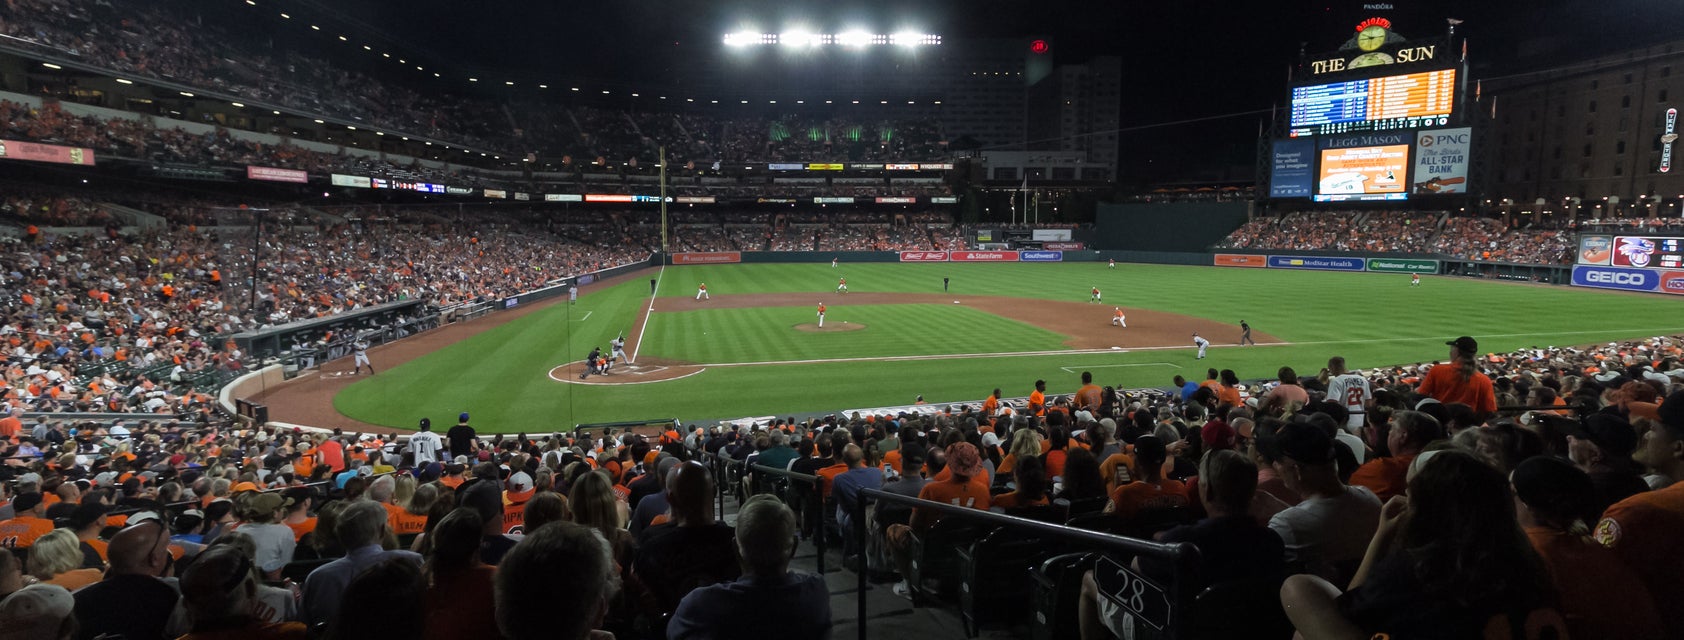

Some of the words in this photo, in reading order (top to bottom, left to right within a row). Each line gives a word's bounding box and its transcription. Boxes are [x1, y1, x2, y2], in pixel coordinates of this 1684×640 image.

[1311, 58, 1345, 74] THE
[1397, 45, 1435, 64] SUN
[1329, 137, 1358, 148] LEGG
[1361, 135, 1402, 146] MASON
[1437, 134, 1468, 145] PNC
[1420, 155, 1464, 165] ALL-STAR
[1429, 165, 1453, 174] BANK
[1586, 270, 1645, 286] GEICO
[1667, 280, 1684, 289] HO
[503, 511, 524, 524] RIPK
[1114, 569, 1145, 613] 28
